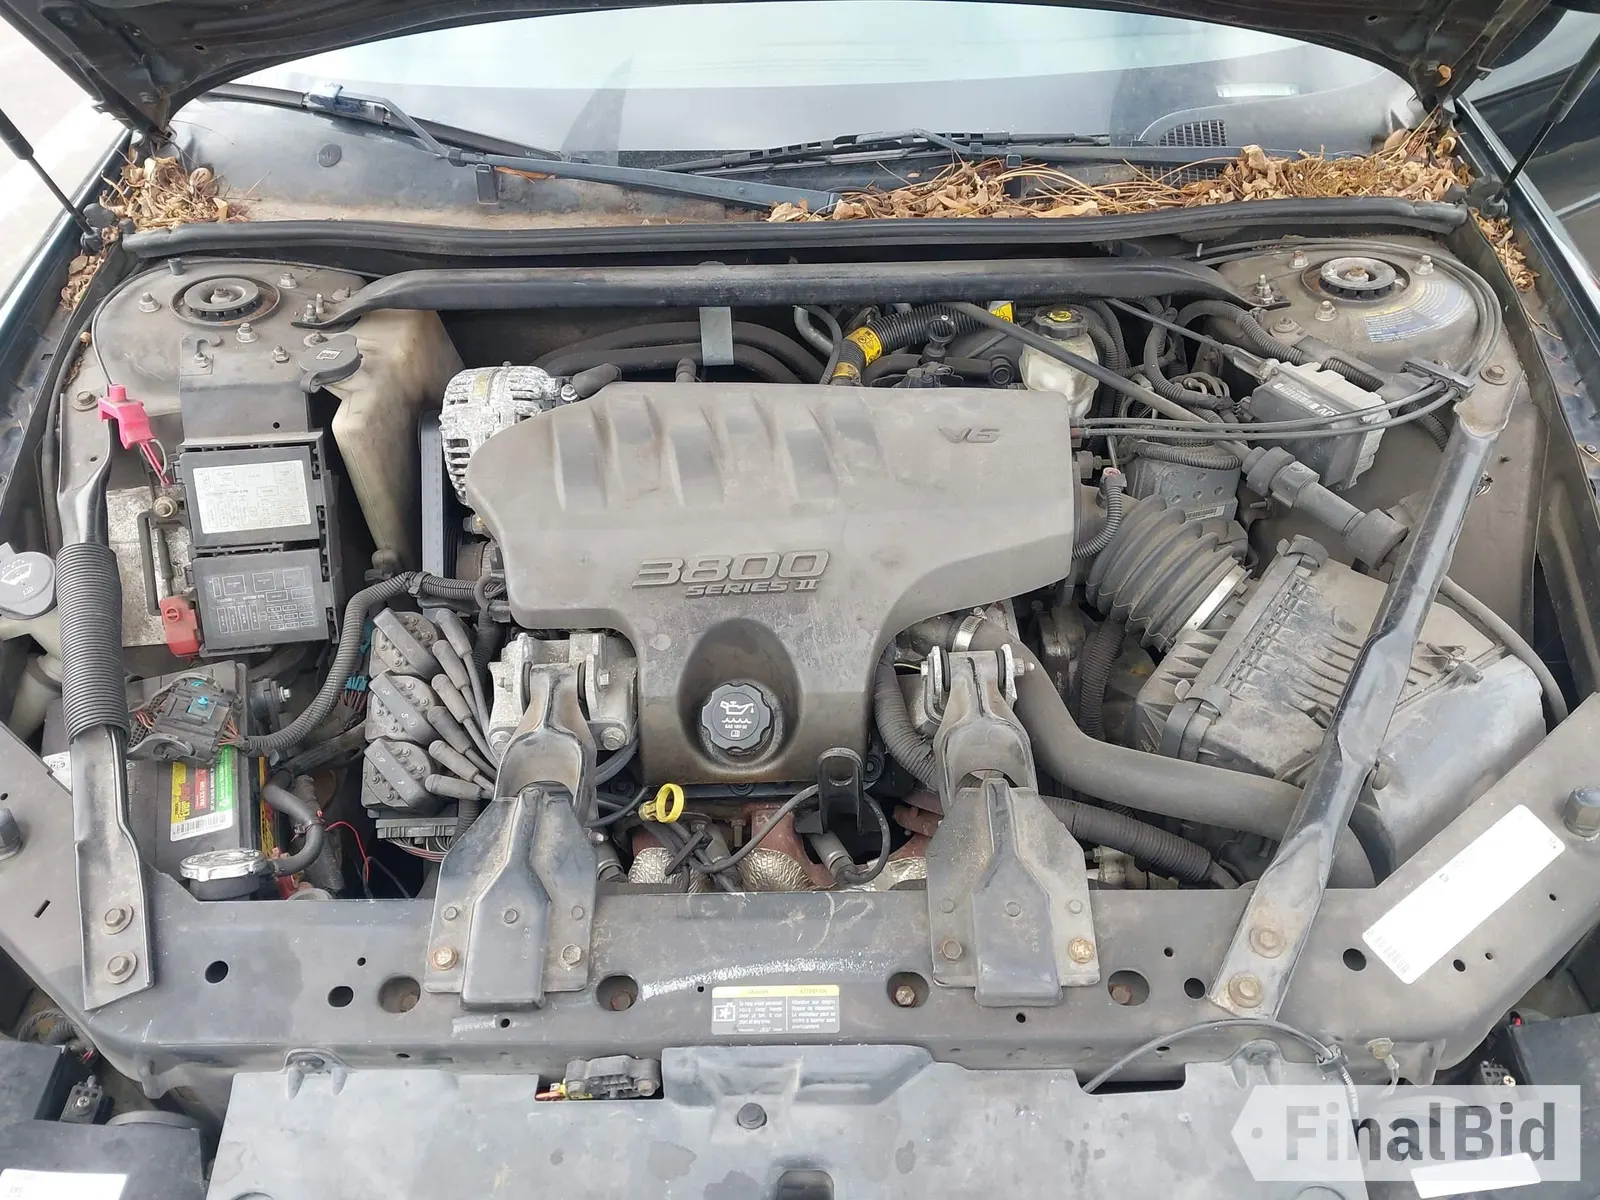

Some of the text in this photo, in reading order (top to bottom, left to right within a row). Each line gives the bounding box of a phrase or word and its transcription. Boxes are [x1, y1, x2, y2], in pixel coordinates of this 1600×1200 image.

[937, 426, 1000, 444] V6
[632, 550, 830, 589] 3800
[685, 579, 821, 599] SERIES II
